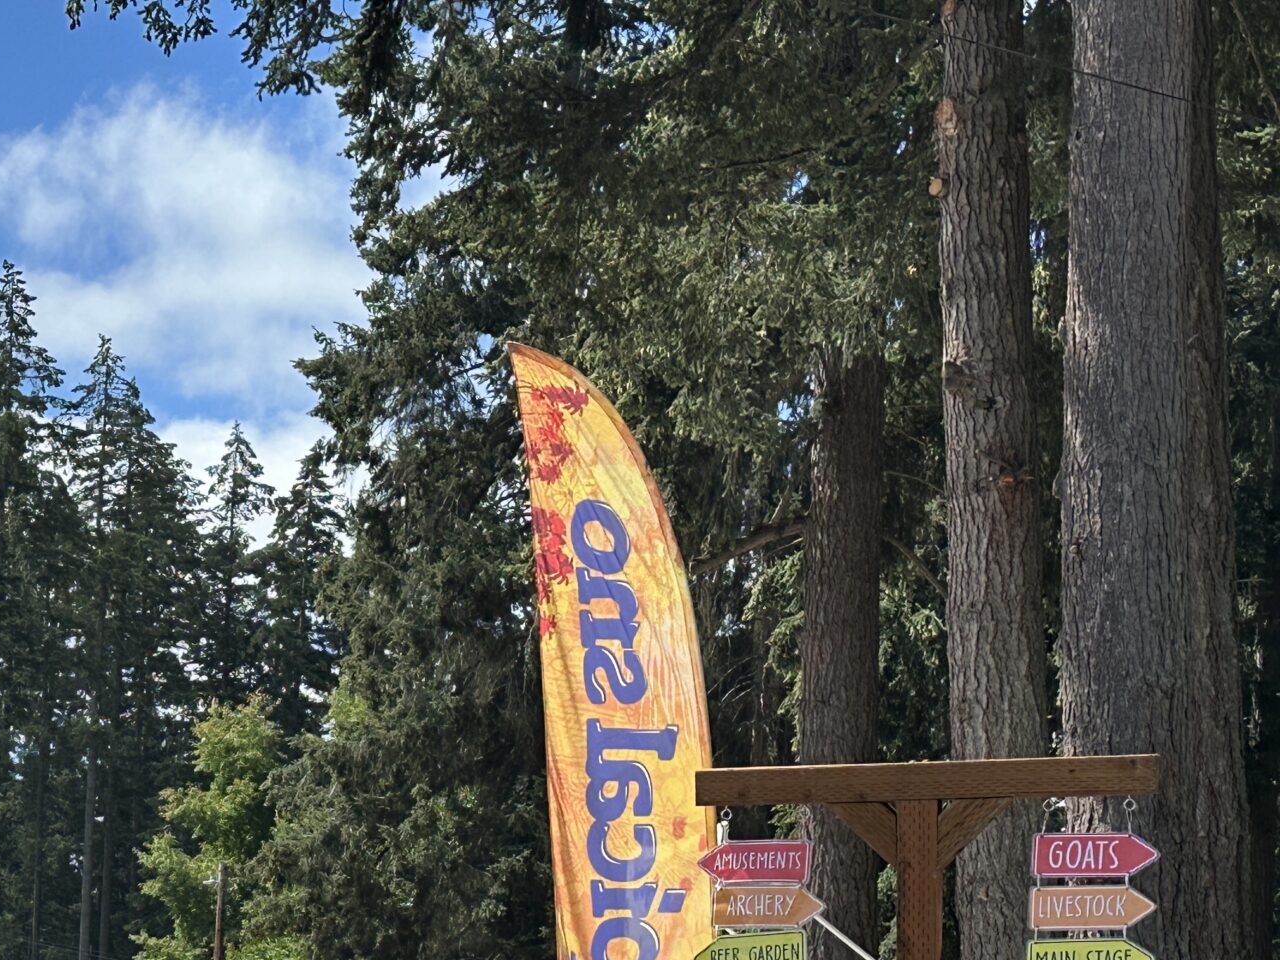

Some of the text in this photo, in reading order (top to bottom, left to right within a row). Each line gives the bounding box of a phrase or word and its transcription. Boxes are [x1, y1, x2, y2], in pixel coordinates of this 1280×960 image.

[713, 851, 801, 870] AMUSEMENTS
[1049, 840, 1119, 869] GOATS
[726, 894, 796, 916] ARCHERY
[1039, 894, 1127, 919] LIVESTOCK
